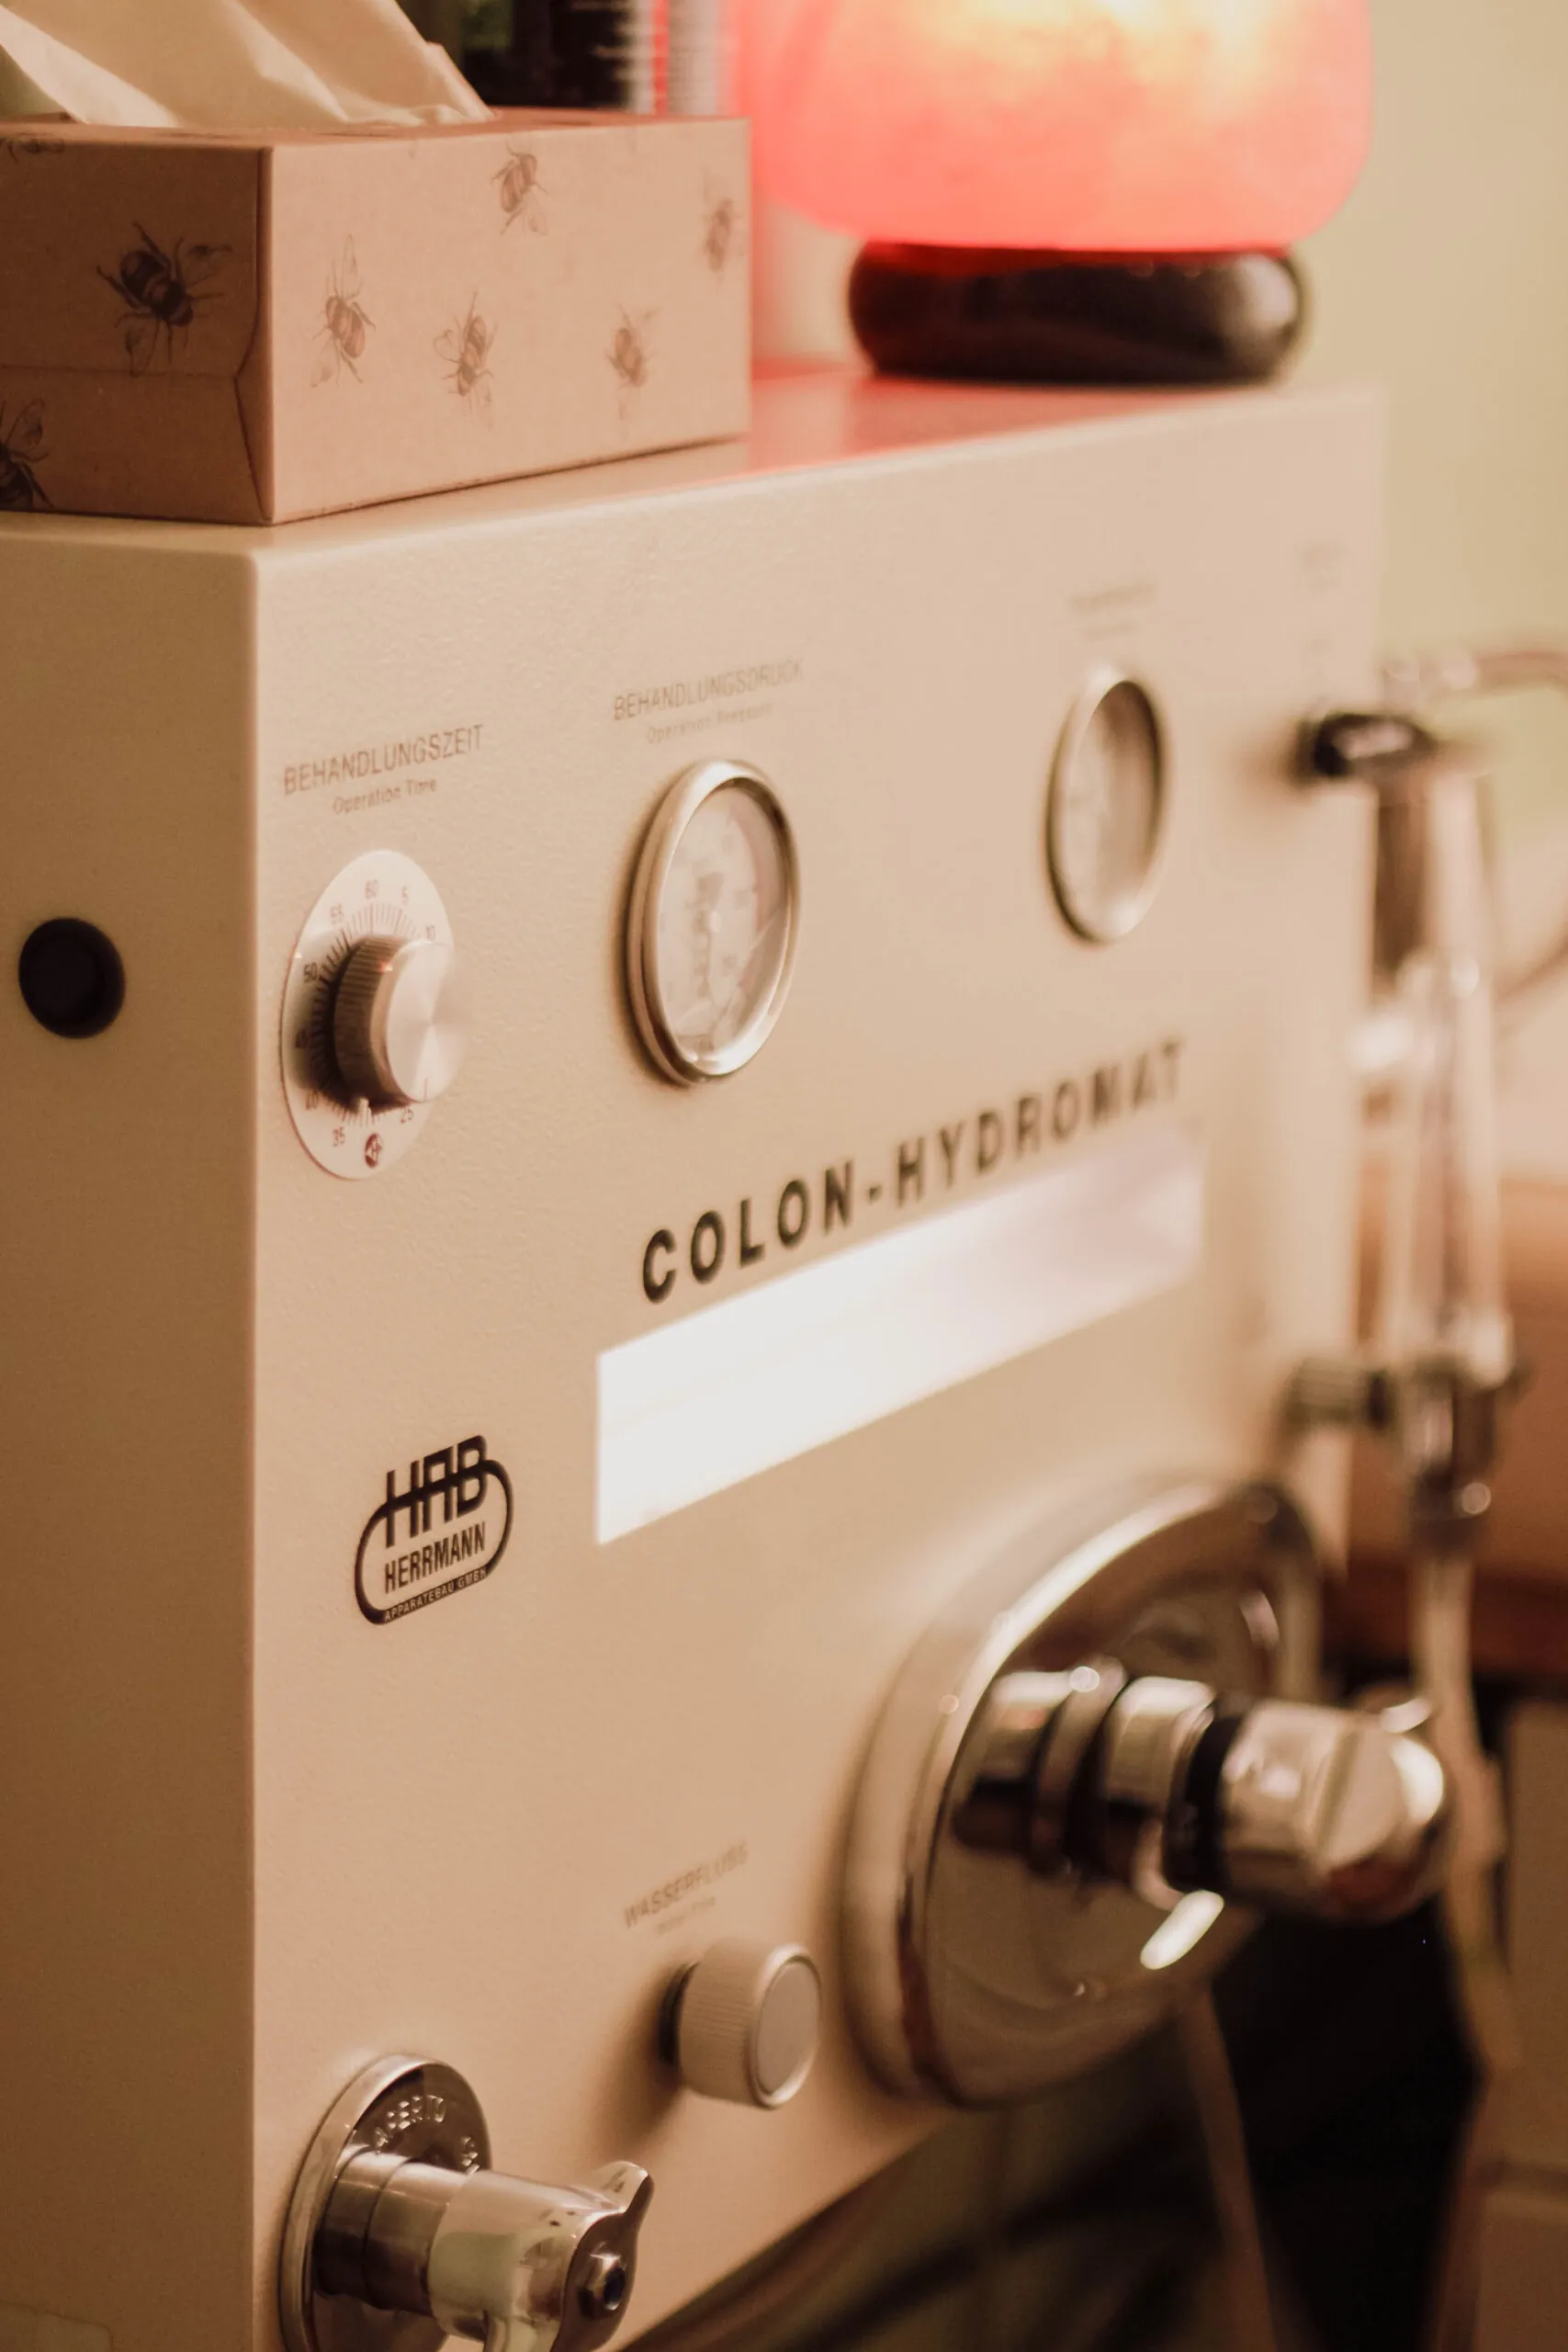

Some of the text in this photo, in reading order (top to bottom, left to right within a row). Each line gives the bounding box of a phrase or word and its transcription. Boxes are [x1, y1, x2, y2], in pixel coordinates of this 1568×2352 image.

[284, 724, 483, 797] BEHANDLUNGSZEIT
[303, 962, 318, 983] 50
[642, 1037, 1183, 1306] COLON-HYDROMAT
[384, 1521, 486, 1595] HERRMANN
[384, 1581, 456, 1623] APPARATEBAU
